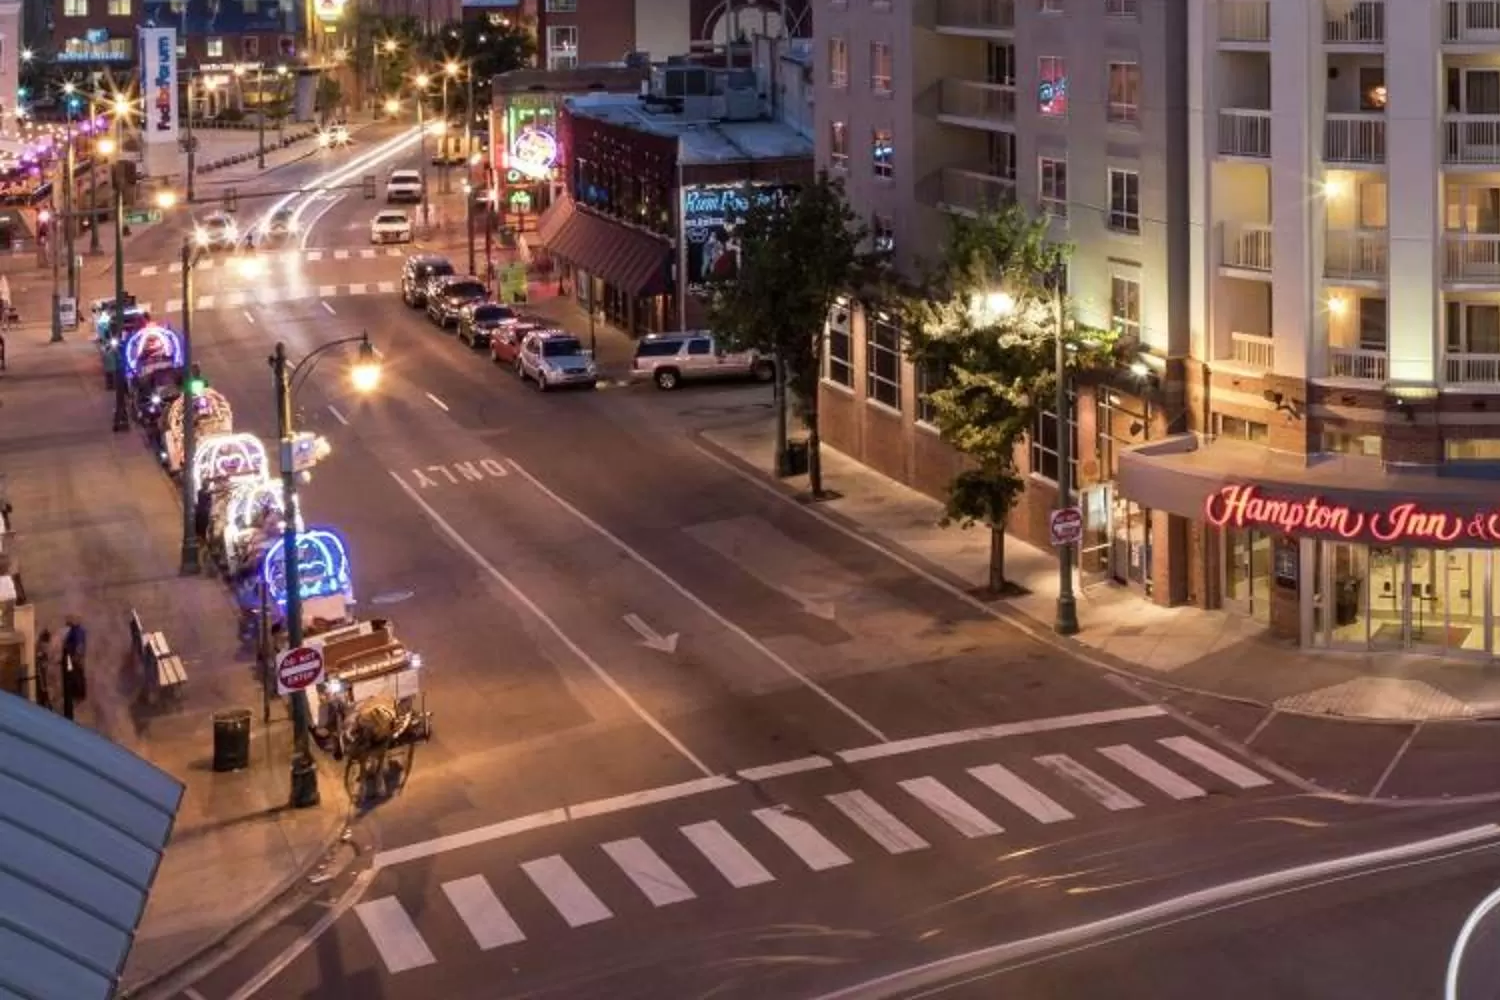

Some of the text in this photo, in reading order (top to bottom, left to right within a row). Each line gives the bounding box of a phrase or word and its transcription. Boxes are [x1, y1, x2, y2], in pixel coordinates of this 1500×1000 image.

[412, 459, 508, 488] ONLY
[1206, 485, 1362, 538] Hampton
[1370, 504, 1463, 541] Inn
